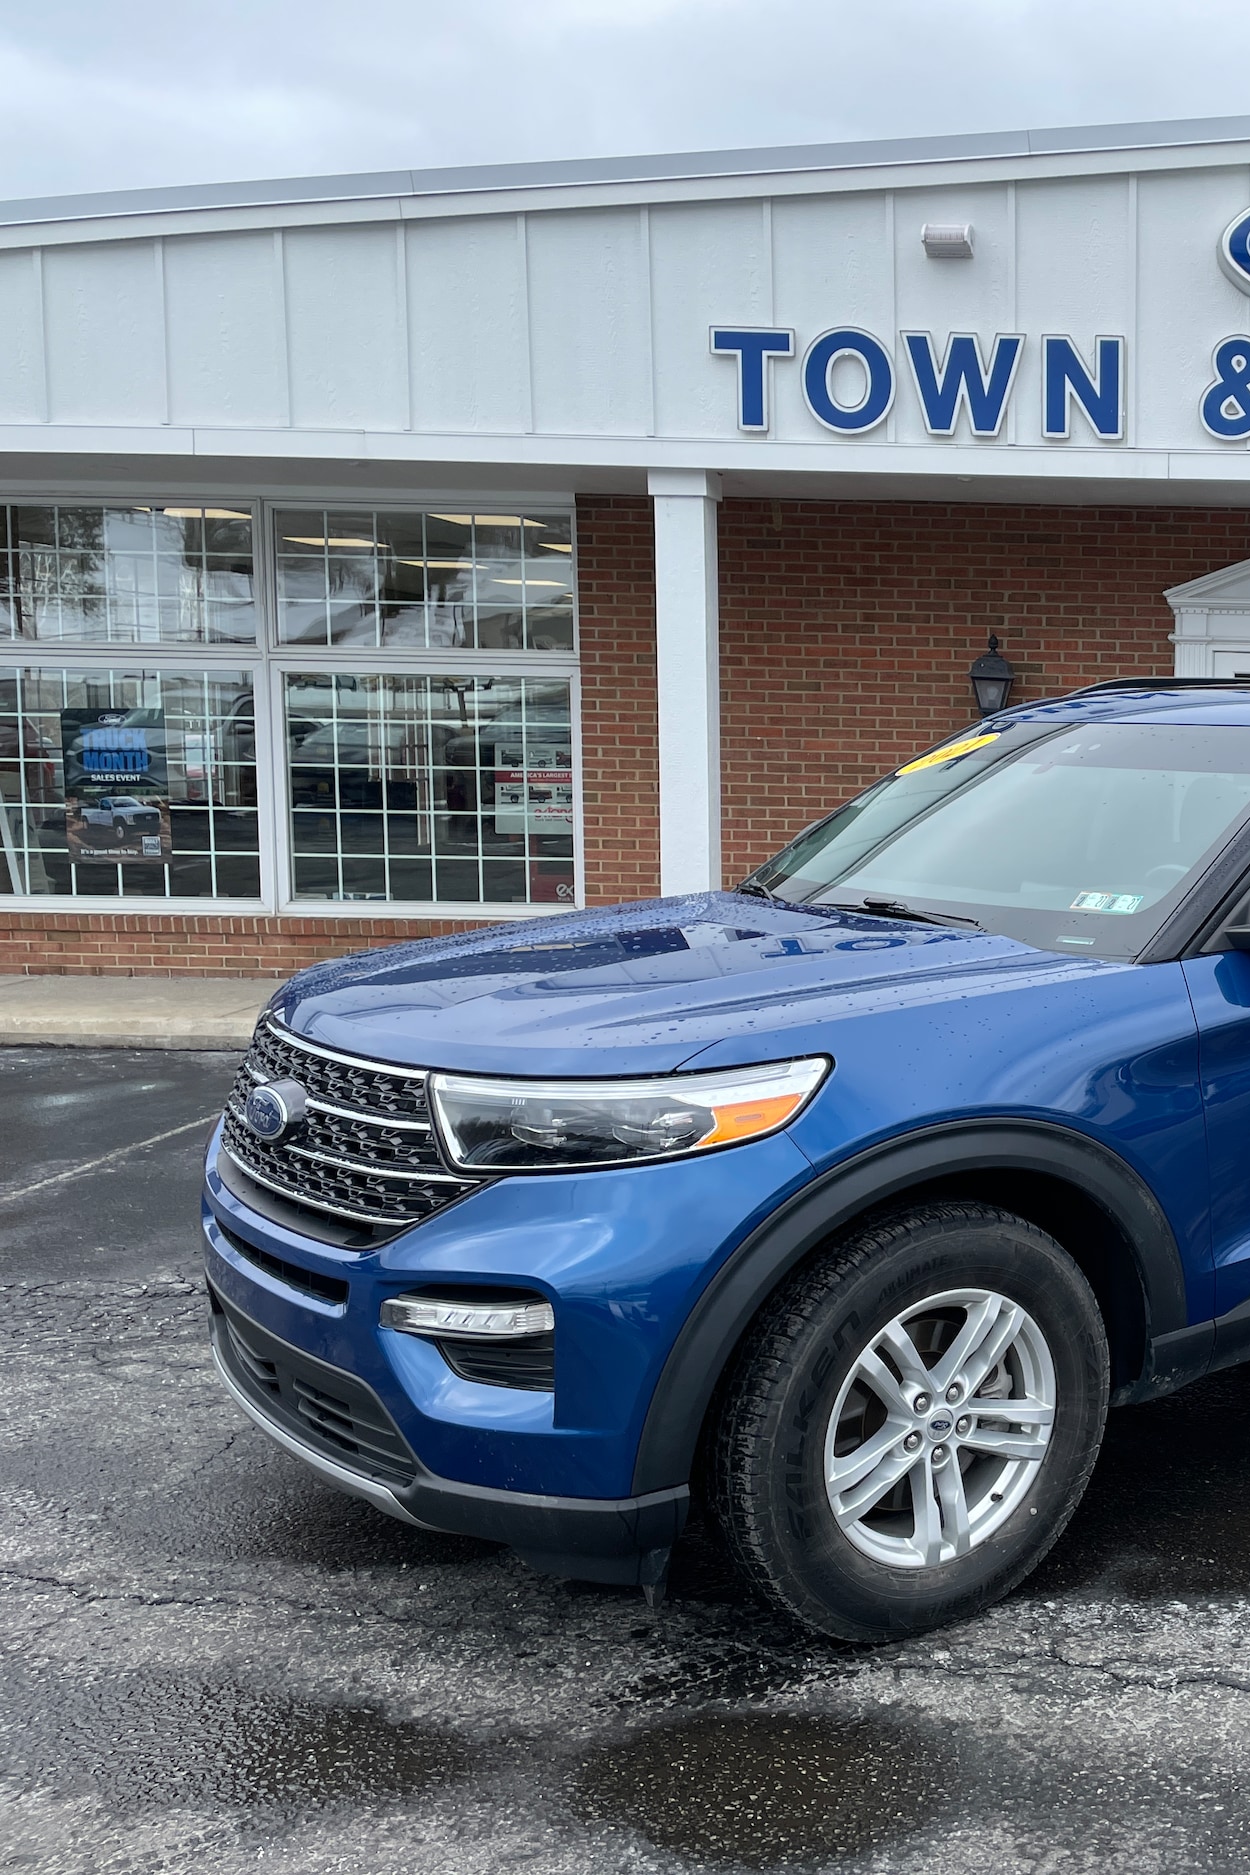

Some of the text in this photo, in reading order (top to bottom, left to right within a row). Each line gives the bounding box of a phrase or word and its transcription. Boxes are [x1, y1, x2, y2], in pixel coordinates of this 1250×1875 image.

[711, 326, 1126, 442] TOWN
[80, 728, 147, 750] TRUCK
[83, 750, 149, 772] MONTH
[91, 774, 141, 782] SALES EVENT
